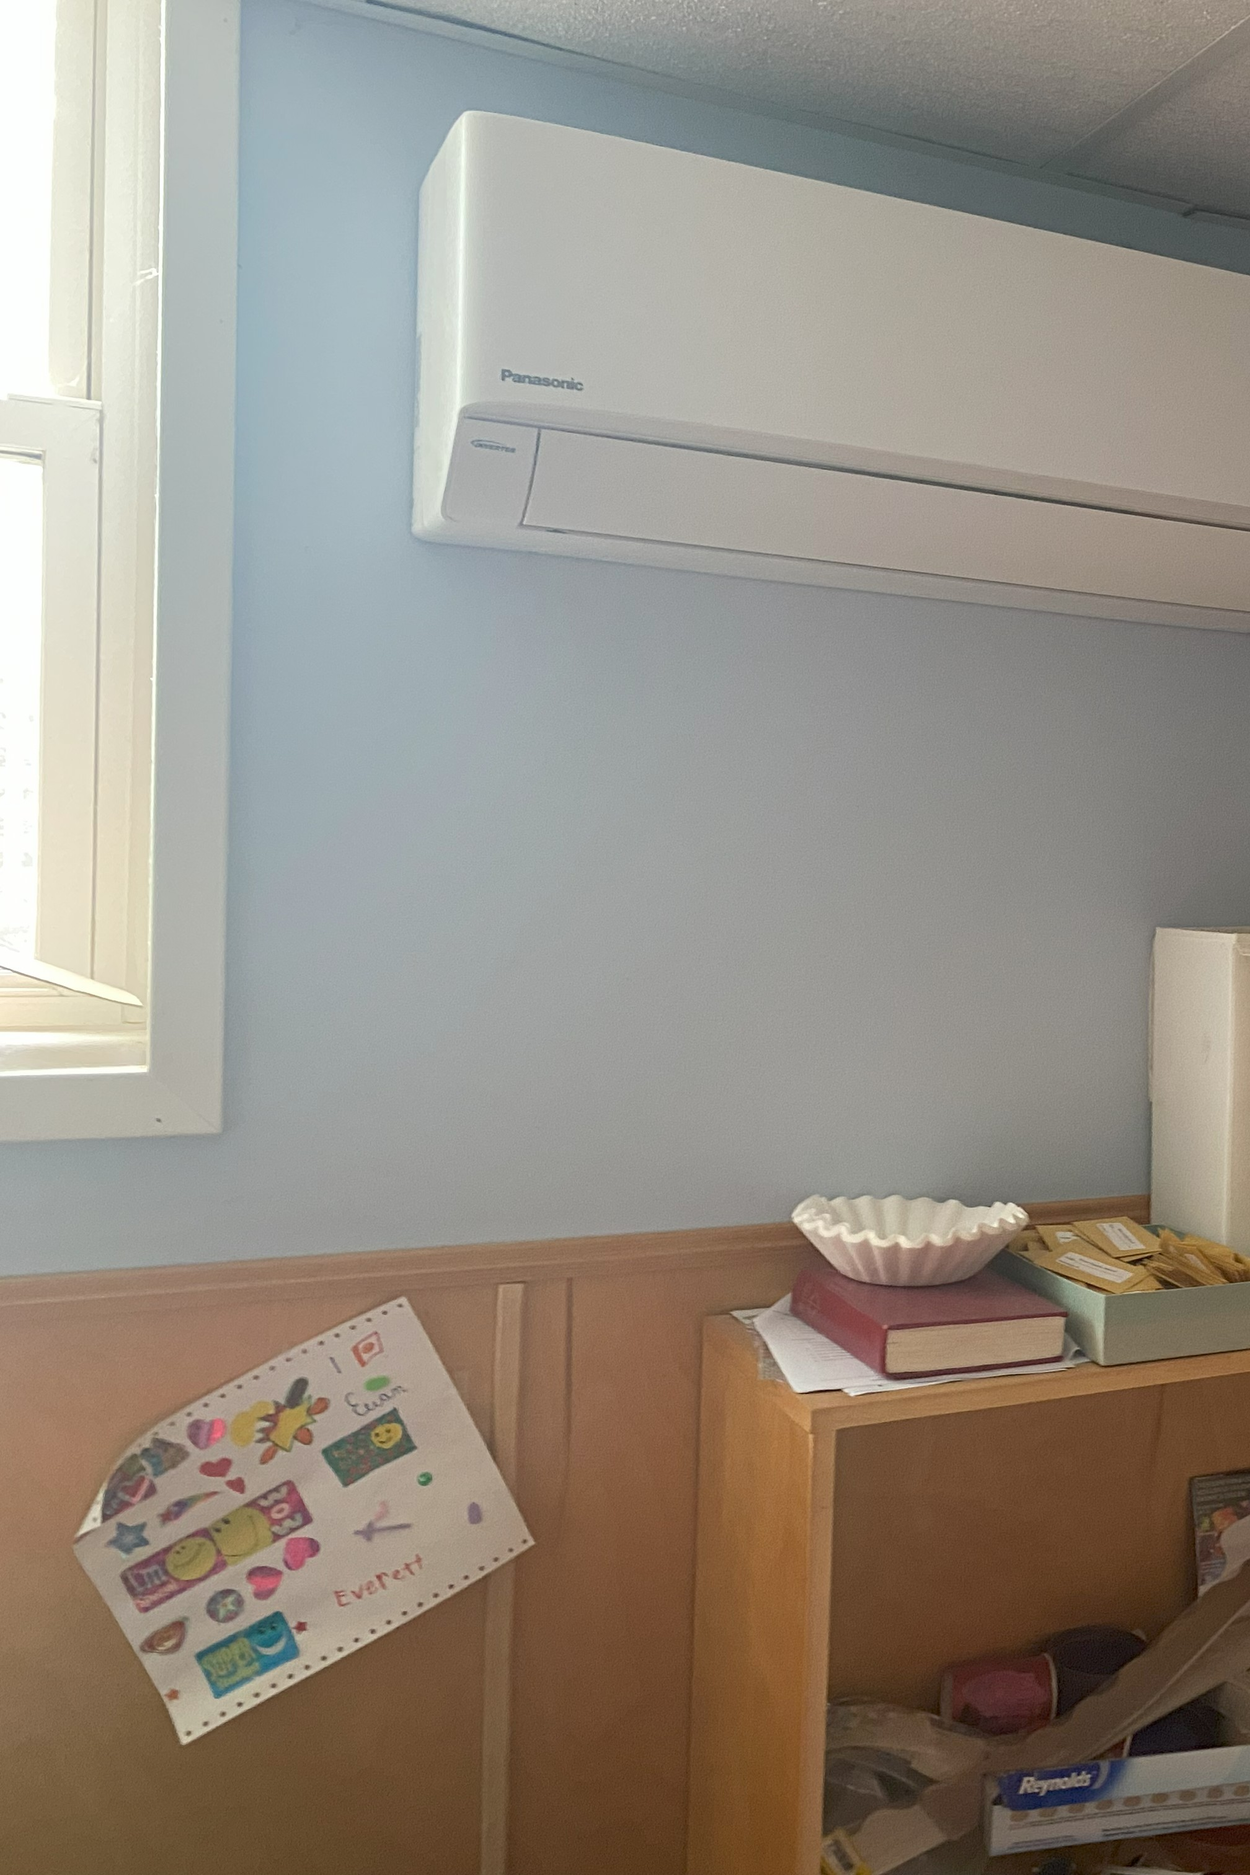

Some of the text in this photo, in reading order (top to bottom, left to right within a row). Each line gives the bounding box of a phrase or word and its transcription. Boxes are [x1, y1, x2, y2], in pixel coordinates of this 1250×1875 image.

[501, 369, 584, 391] Panasonic
[333, 1554, 424, 1608] Everett
[1018, 1769, 1095, 1797] Reynolds
